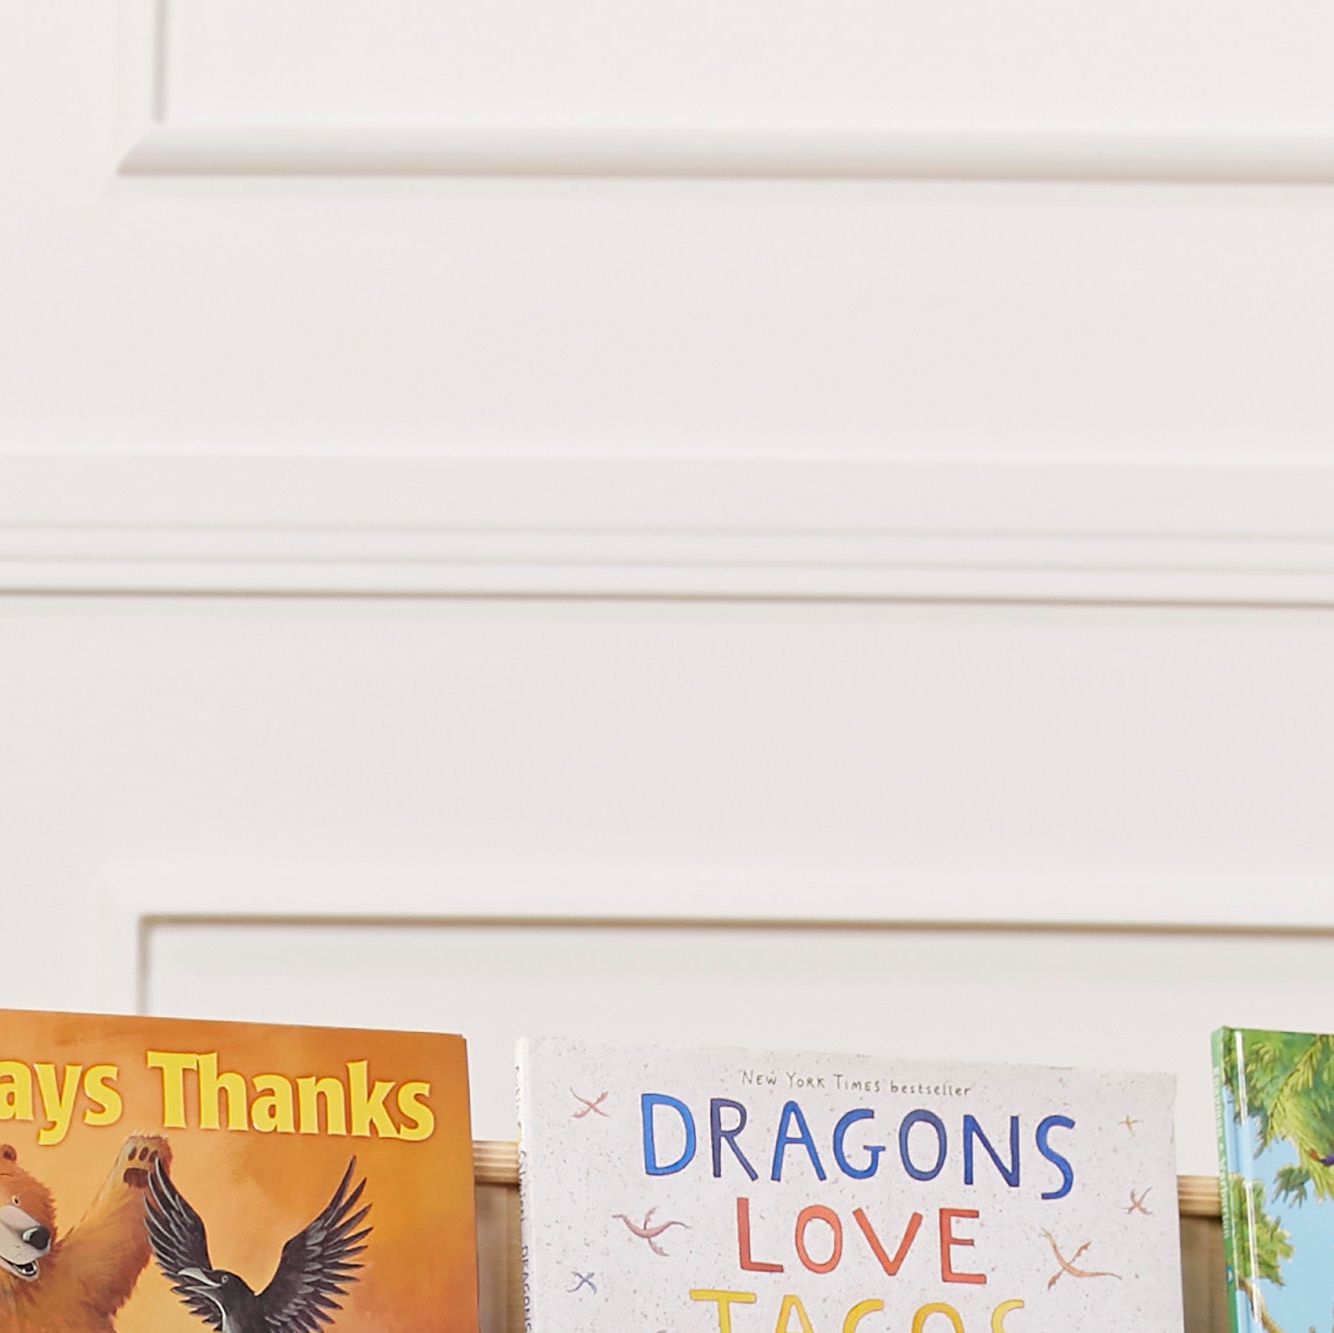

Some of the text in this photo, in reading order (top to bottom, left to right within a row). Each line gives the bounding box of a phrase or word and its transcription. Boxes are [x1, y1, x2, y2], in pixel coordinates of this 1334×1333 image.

[147, 1049, 435, 1142] Thanks
[890, 1080, 972, 1096] bestseller
[640, 1092, 1076, 1200] DRAGONS
[736, 1196, 987, 1285] LOVE
